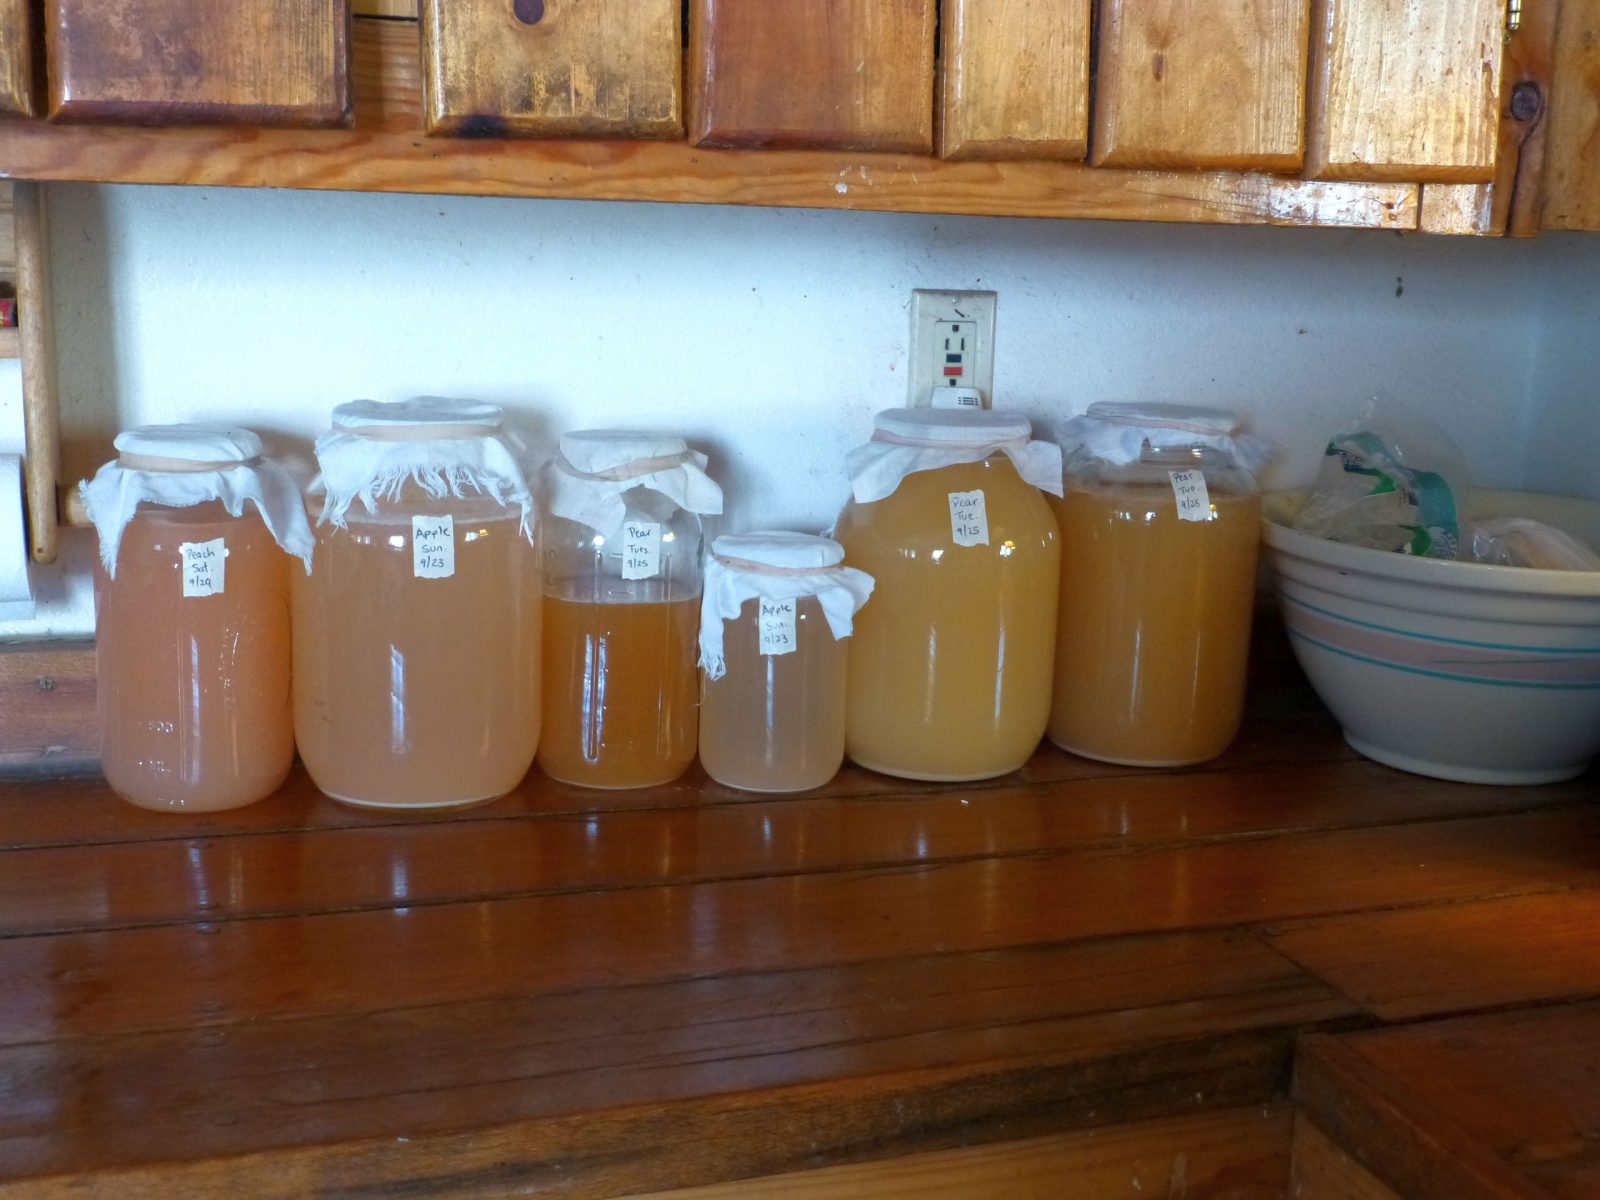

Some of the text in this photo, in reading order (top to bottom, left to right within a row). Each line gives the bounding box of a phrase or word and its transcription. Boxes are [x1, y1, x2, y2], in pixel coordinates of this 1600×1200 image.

[415, 525, 451, 540] Apple
[627, 526, 651, 539] Pear
[186, 547, 216, 560] Peach
[420, 555, 445, 568] 9/23
[627, 558, 649, 568] 9/25
[762, 604, 792, 616] Apple
